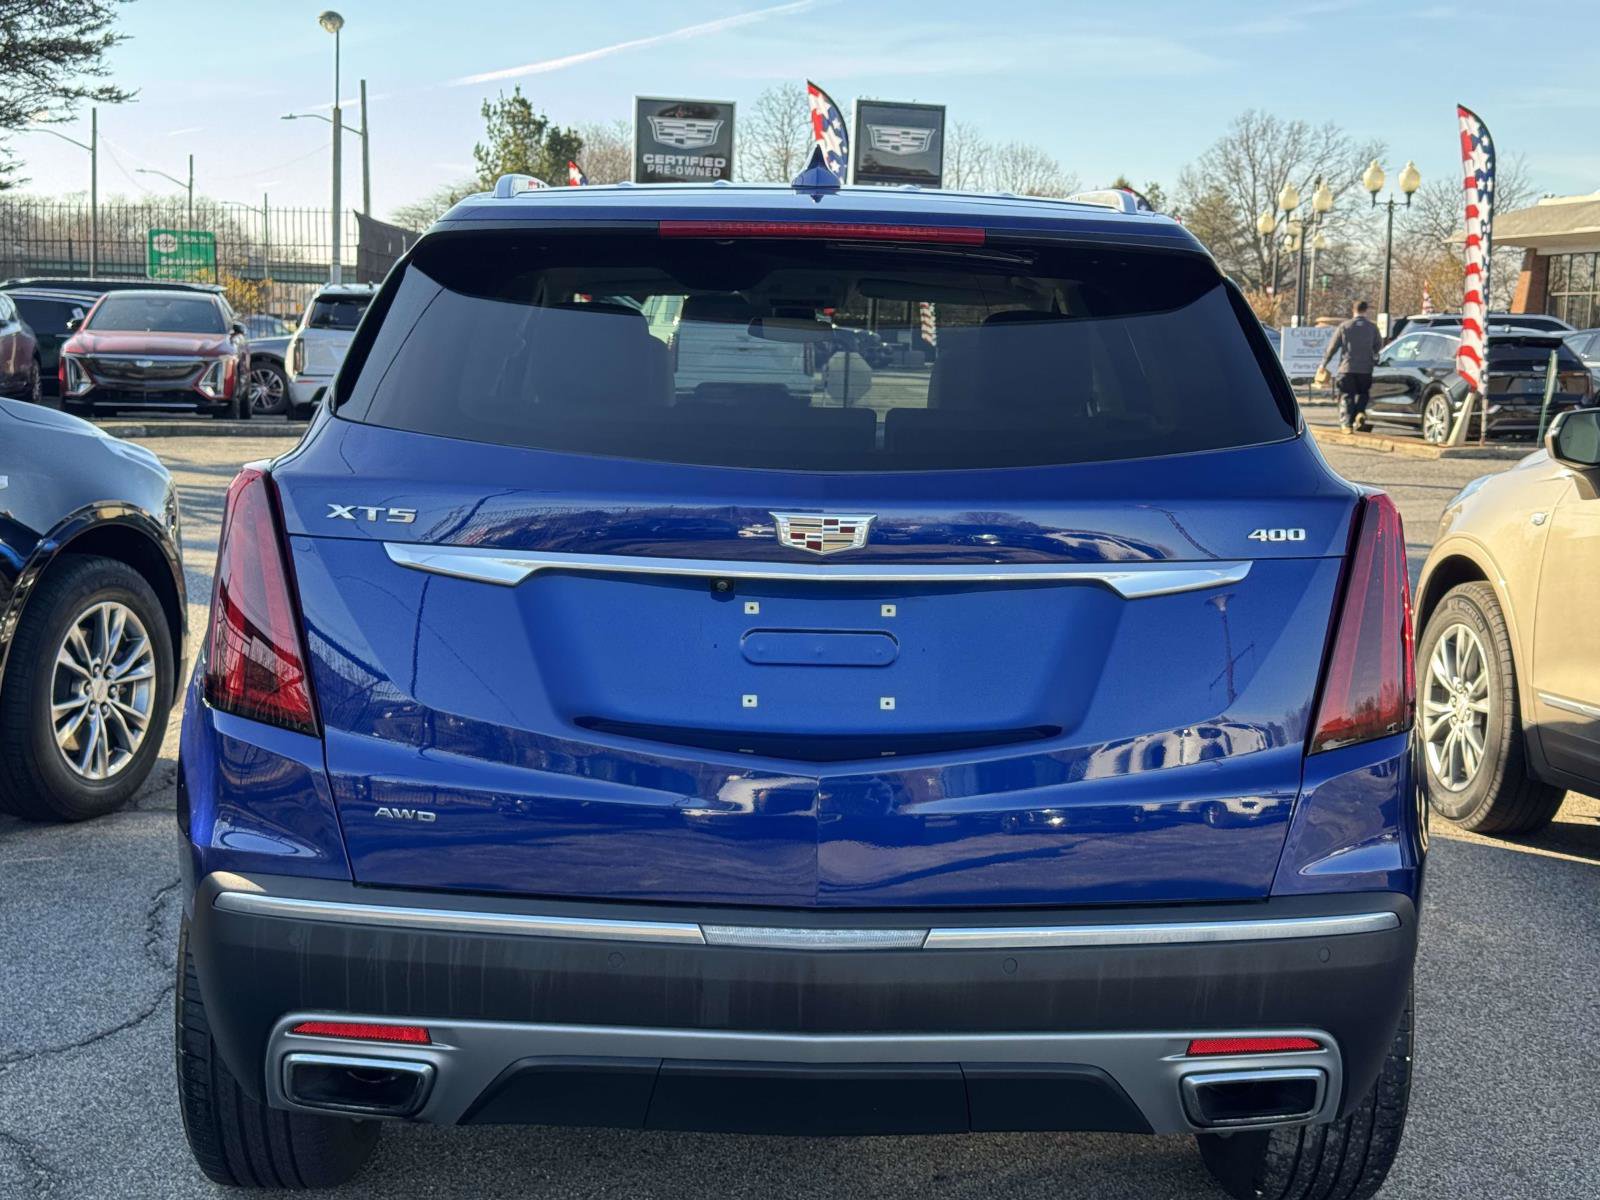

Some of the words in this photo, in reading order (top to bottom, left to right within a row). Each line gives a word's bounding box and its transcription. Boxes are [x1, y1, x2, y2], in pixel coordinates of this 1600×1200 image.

[642, 153, 726, 168] CERTIFIED
[647, 164, 721, 177] PRE-OWNED
[326, 503, 417, 524] XT5
[1247, 528, 1306, 542] 400
[375, 807, 436, 822] AWD
